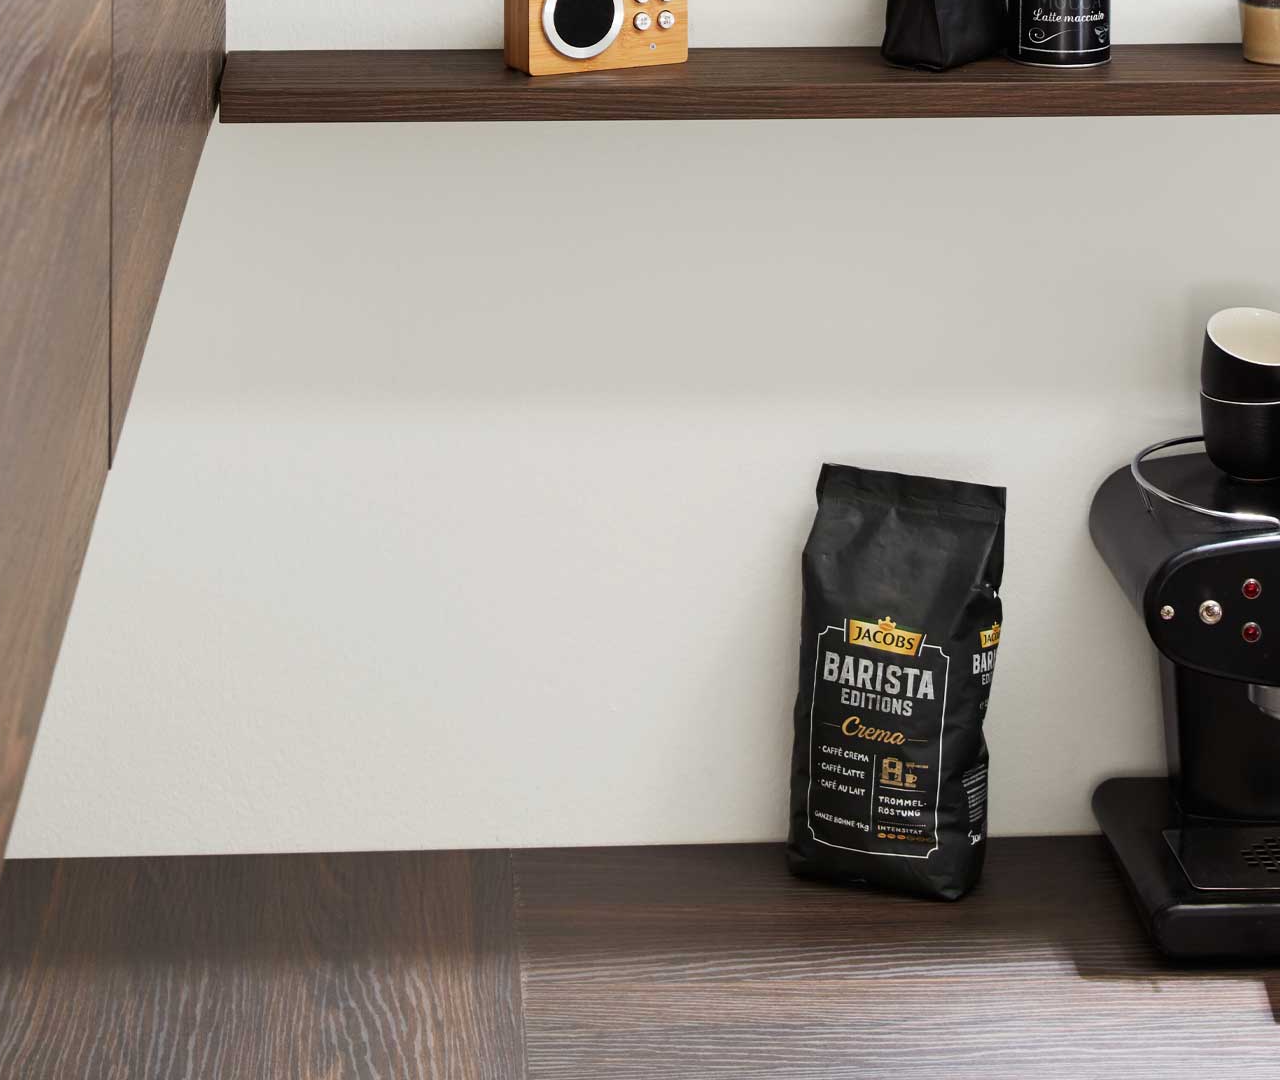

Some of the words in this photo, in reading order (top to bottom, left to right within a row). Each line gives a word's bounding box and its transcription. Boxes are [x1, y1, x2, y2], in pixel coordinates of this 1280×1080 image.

[1032, 7, 1062, 23] Latte
[852, 626, 915, 650] JACOBS
[823, 651, 935, 700] BARISTA
[840, 687, 913, 717] EDITIONS
[841, 716, 906, 745] Crema
[843, 750, 869, 762] CREMA
[842, 767, 865, 779] LATTE
[837, 784, 848, 793] AU
[848, 786, 866, 796] LAIT
[878, 795, 927, 807] TROMMEL-
